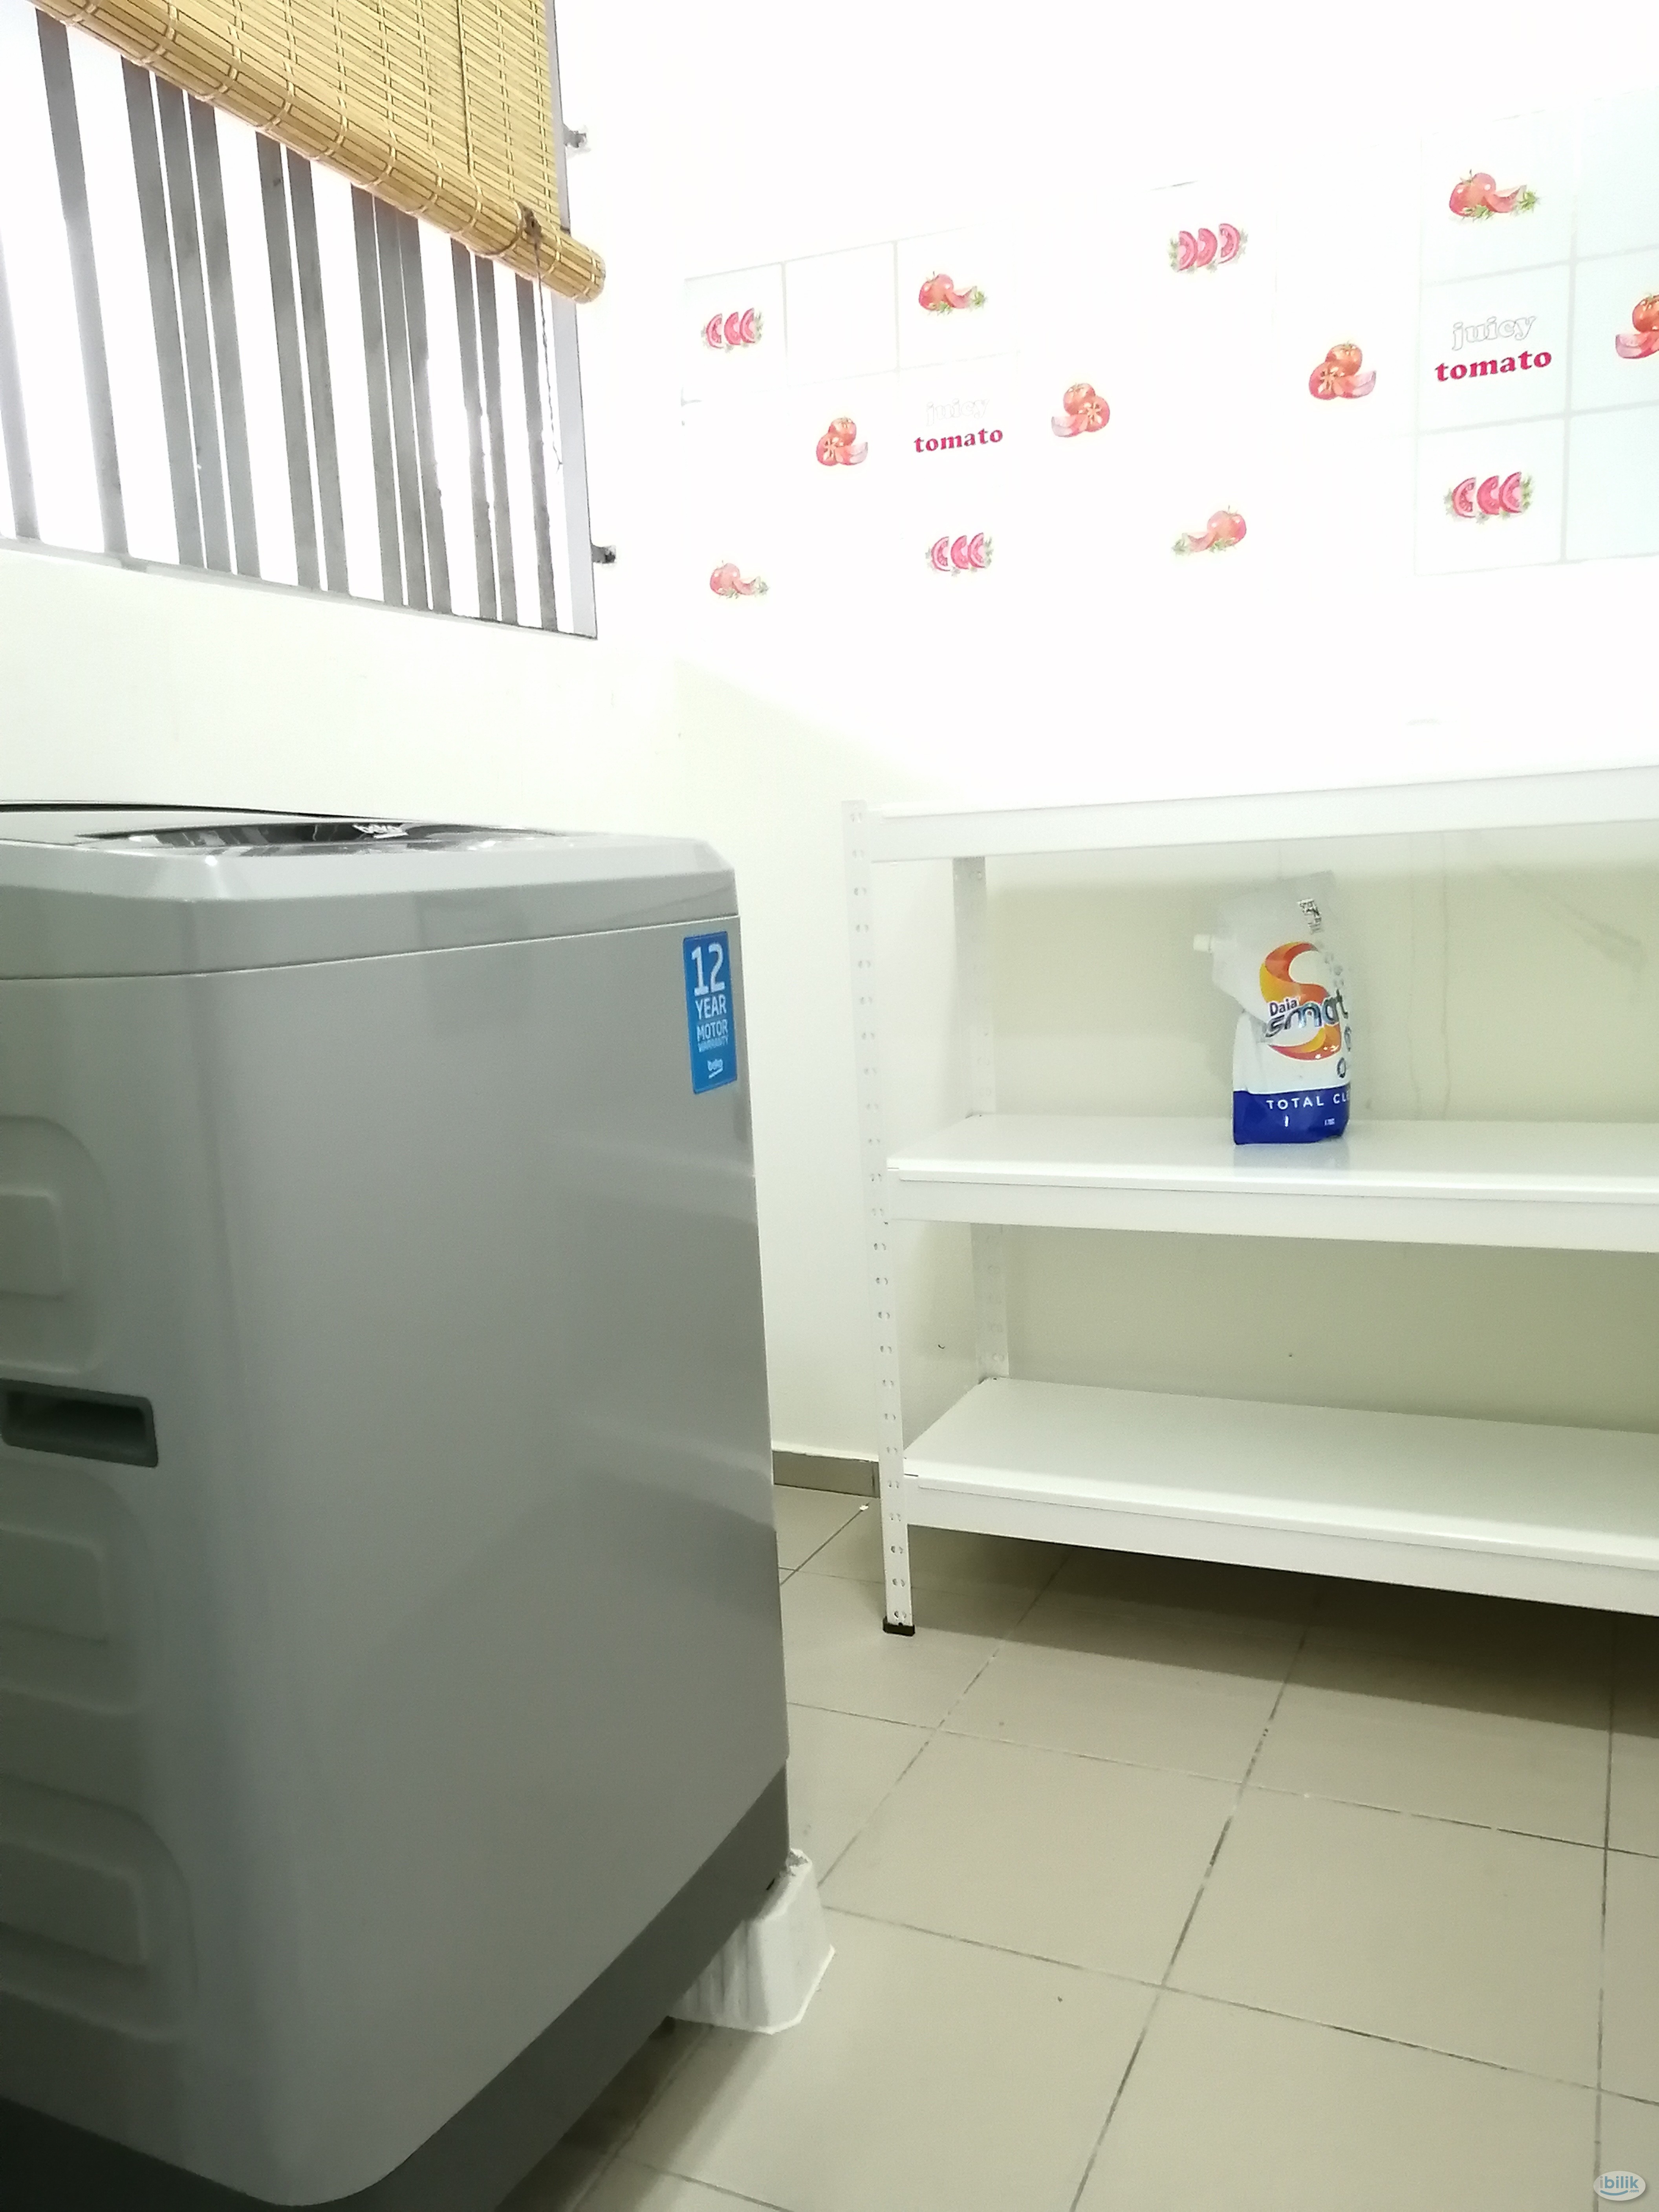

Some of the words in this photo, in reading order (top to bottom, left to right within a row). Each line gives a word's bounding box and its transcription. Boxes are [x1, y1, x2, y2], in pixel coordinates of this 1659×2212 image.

[1452, 316, 1536, 351] juicy
[1435, 351, 1552, 382] tomato
[914, 428, 1003, 453] tomato
[691, 943, 725, 996] 12
[695, 994, 727, 1020] YEAR
[1269, 999, 1298, 1016] Daia
[697, 1019, 728, 1042] MOTOR
[1266, 1096, 1324, 1110] TOTAL
